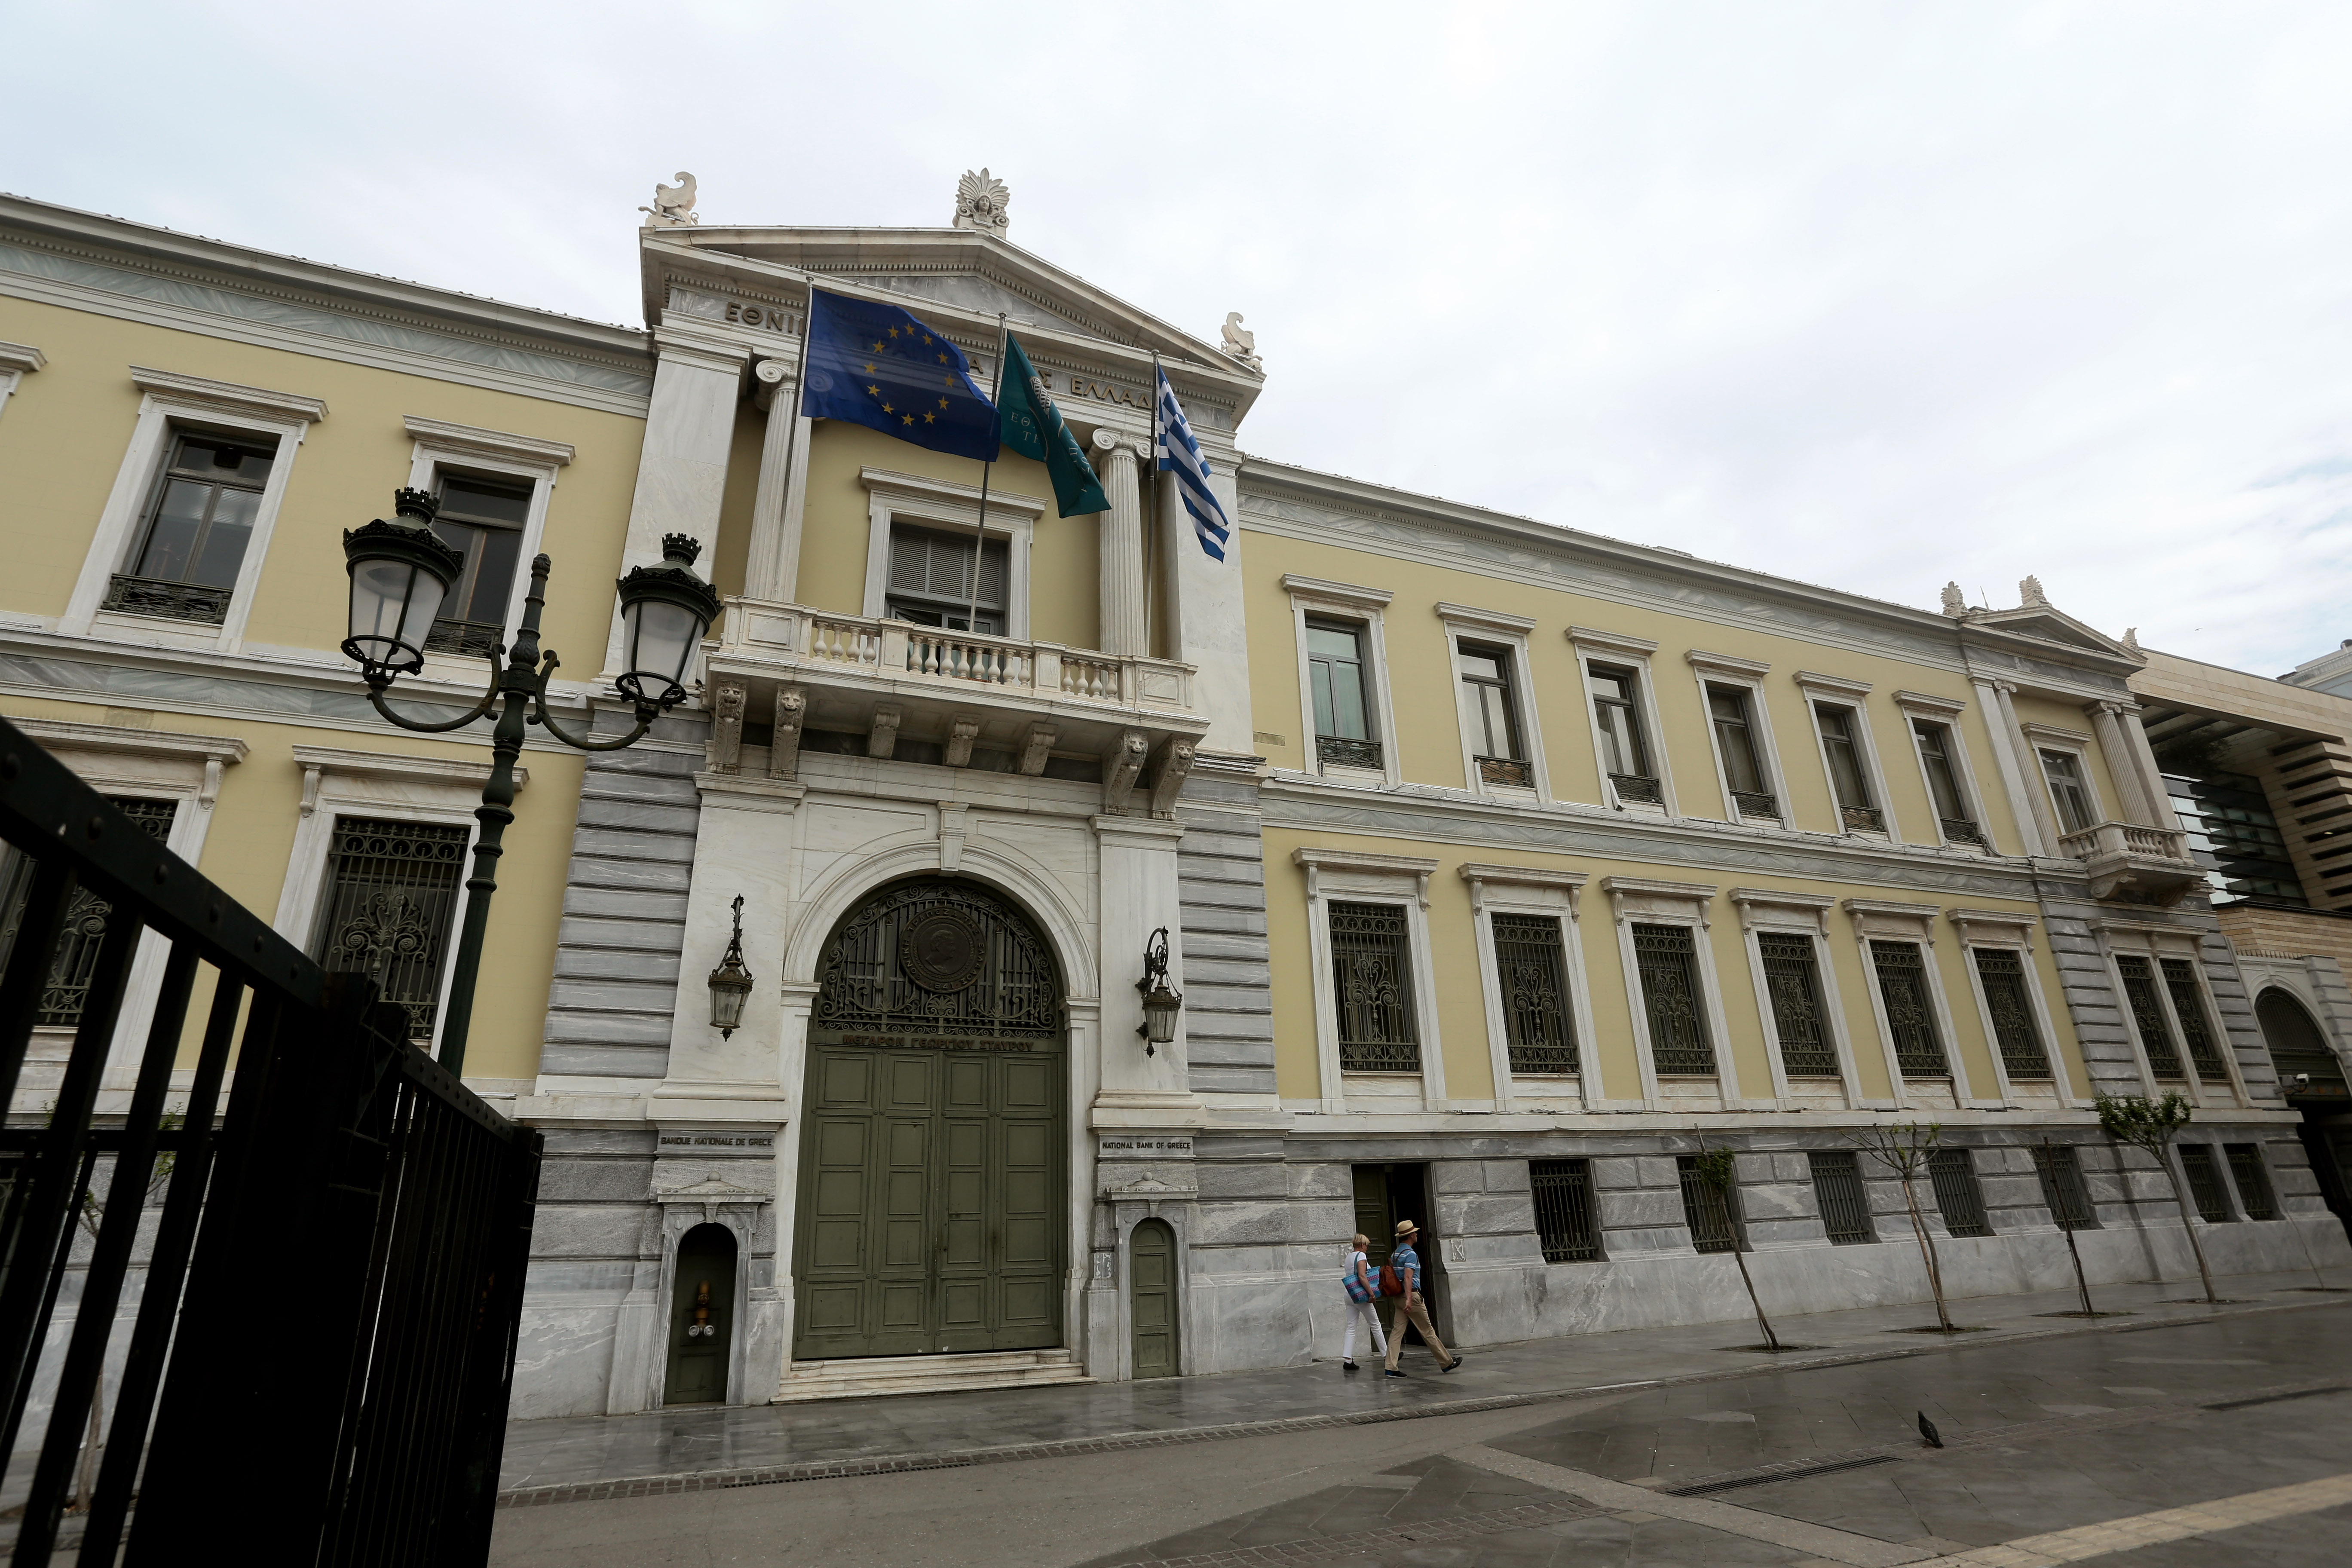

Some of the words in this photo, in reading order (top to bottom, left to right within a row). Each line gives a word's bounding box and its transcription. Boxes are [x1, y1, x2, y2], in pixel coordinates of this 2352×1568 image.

[725, 301, 804, 335] ΕΘΝΙ
[1072, 377, 1185, 411] ΕΛΛΑΔ
[907, 909, 958, 932] ΤΡΑΠΕΖΑ
[963, 916, 980, 936] ΤΗΣ
[902, 940, 922, 980] ΕΘΝΙΚΗ
[960, 943, 985, 985] ΕΛΛΑΔΟΣ
[930, 981, 954, 989] 1841
[843, 1034, 905, 1046] ΜΕΓΑΡΟΝ
[911, 1037, 975, 1049] ΓΕΩΡΓΙΟΥ
[980, 1040, 1034, 1051] ΣΤΑΥΡΟΥ
[694, 1137, 733, 1145] NATIONALE
